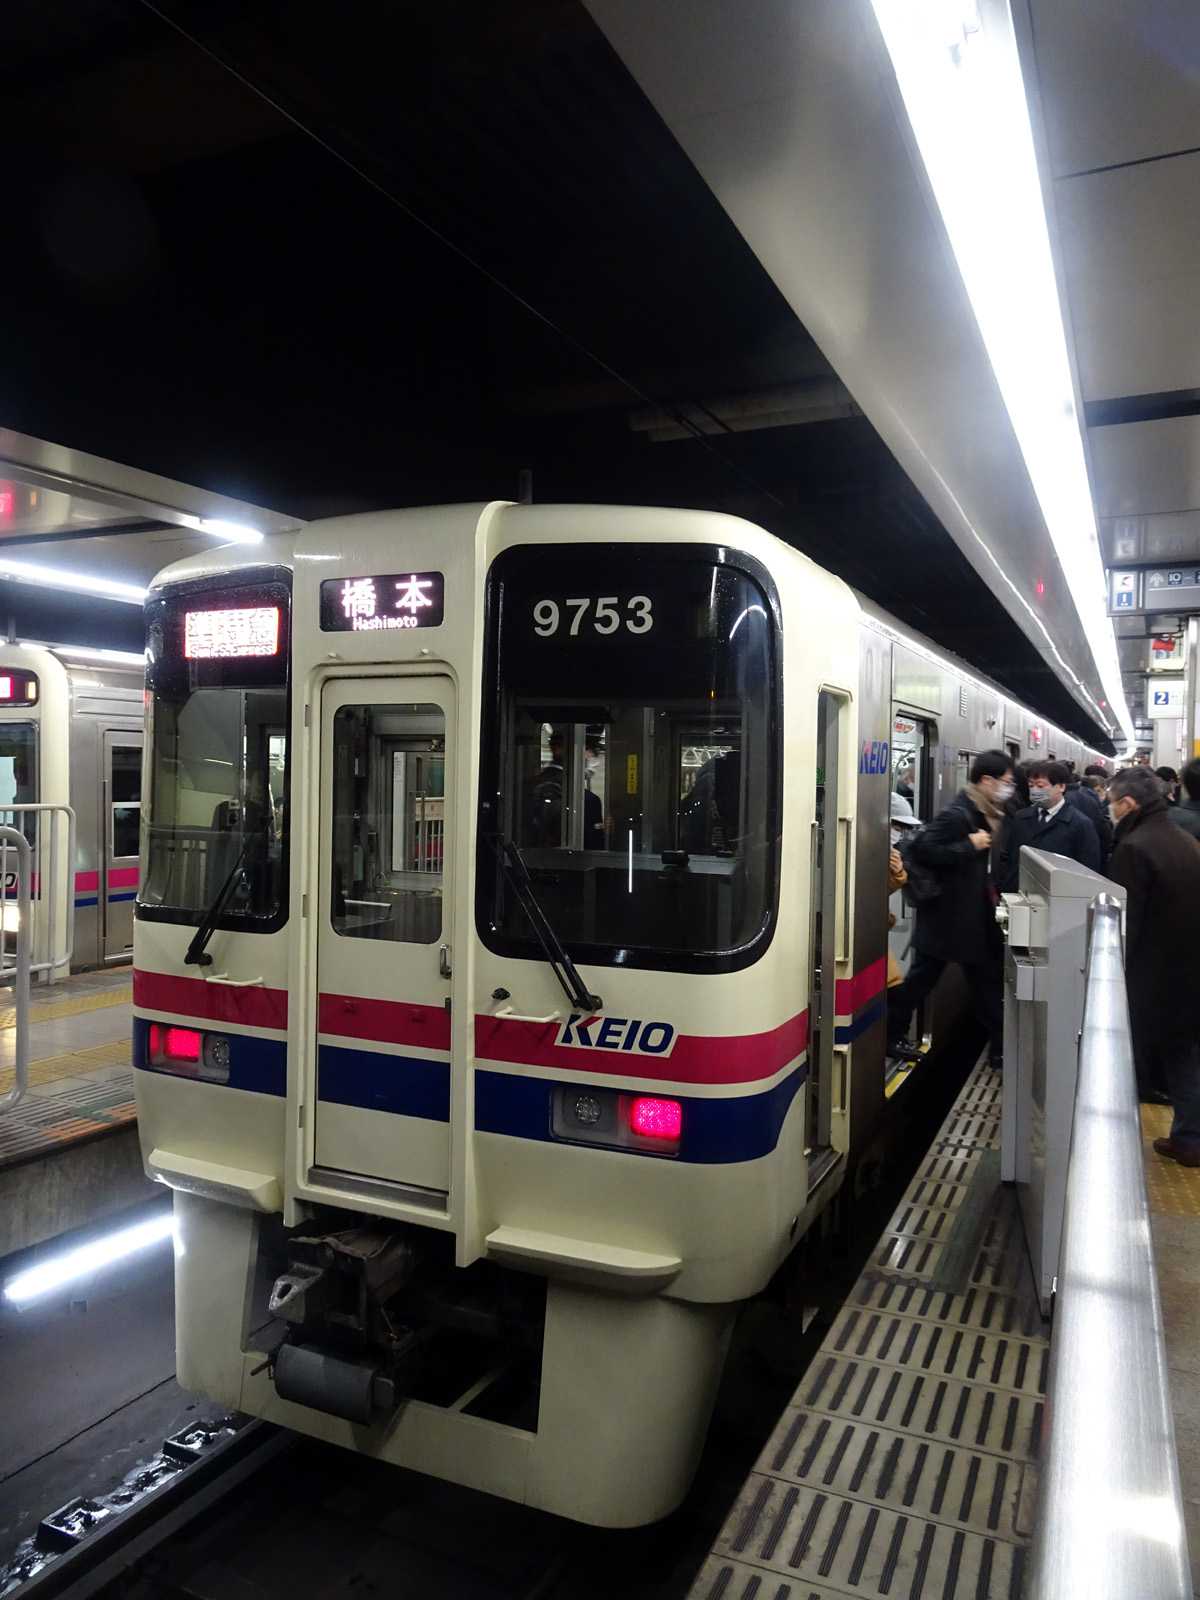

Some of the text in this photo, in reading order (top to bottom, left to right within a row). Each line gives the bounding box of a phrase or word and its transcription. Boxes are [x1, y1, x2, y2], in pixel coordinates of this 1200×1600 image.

[341, 575, 432, 618] 橋本
[353, 615, 418, 631] Hashimoto
[533, 595, 653, 637] 9753
[1156, 692, 1167, 704] 2
[860, 740, 888, 774] KEIO
[561, 1014, 675, 1053] KEIO
